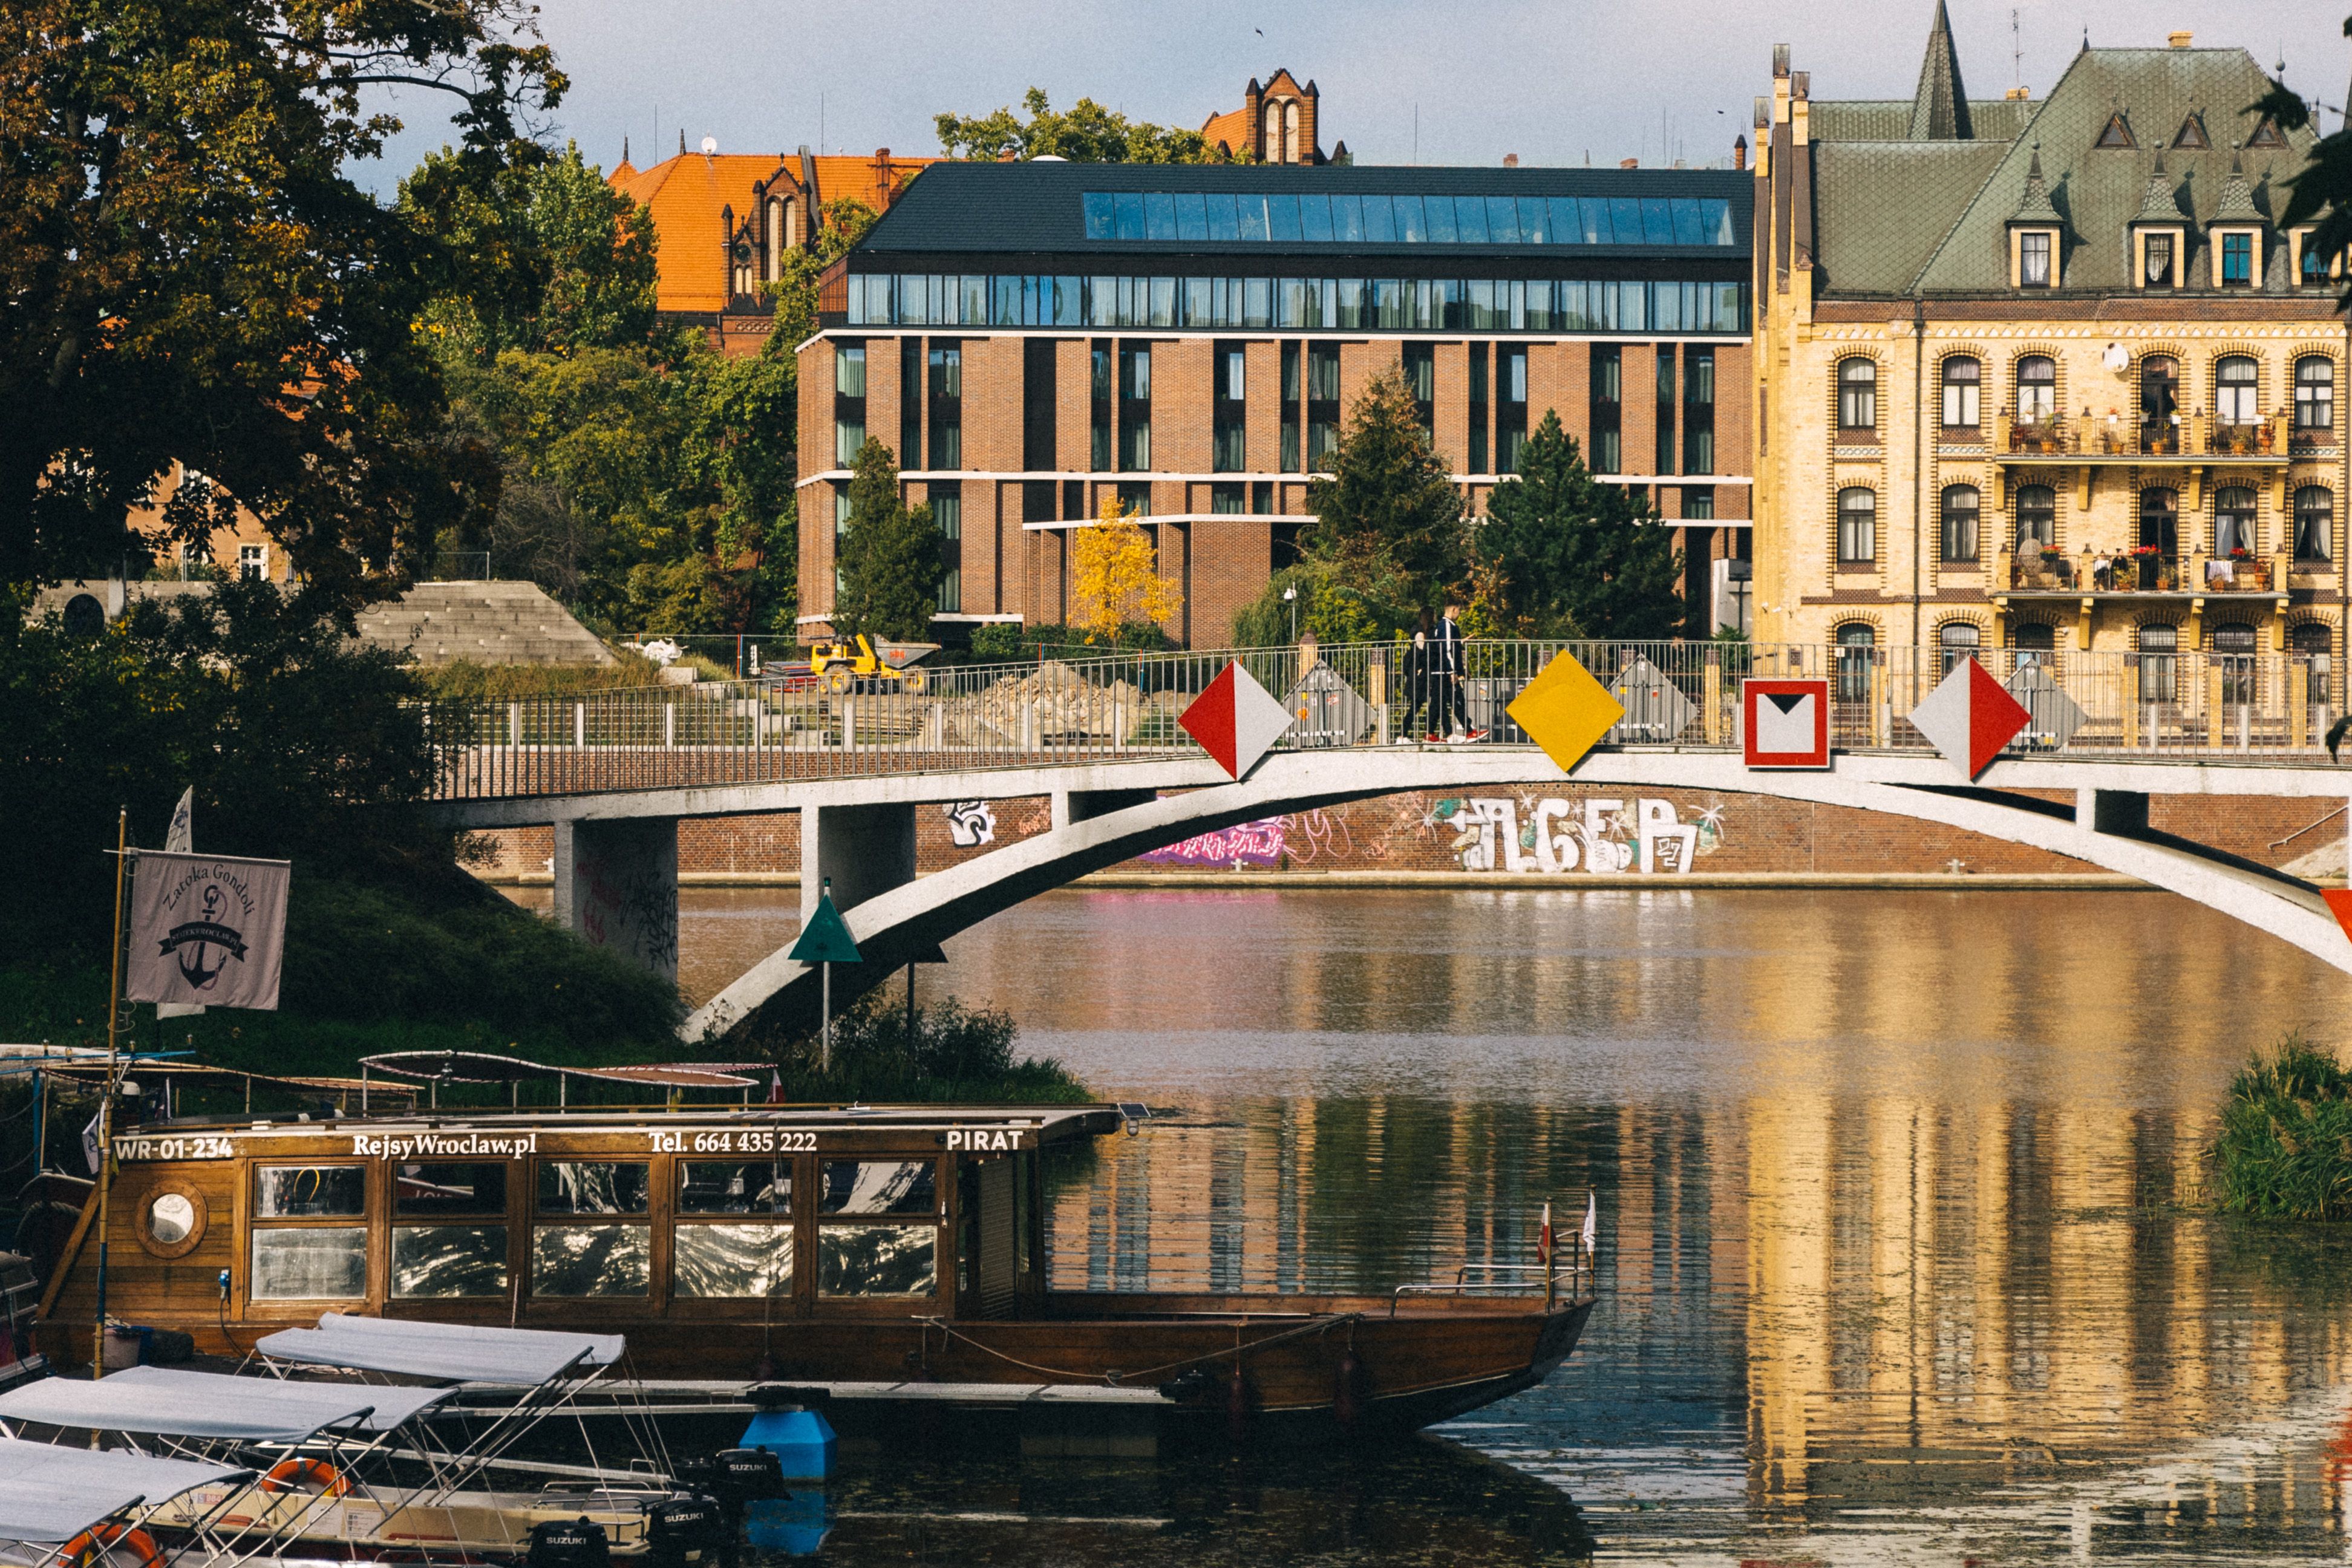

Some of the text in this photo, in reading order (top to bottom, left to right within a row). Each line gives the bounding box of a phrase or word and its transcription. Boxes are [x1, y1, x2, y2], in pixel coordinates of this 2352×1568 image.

[163, 864, 255, 916] Zatoka Gondoli
[115, 1138, 233, 1160] WR-01-234
[353, 1133, 537, 1160] RejsyWroclaw.pl
[648, 1132, 817, 1152] Tel. 664 435 222
[947, 1131, 1024, 1150] PIRAT
[664, 1512, 704, 1523] SUZUKI
